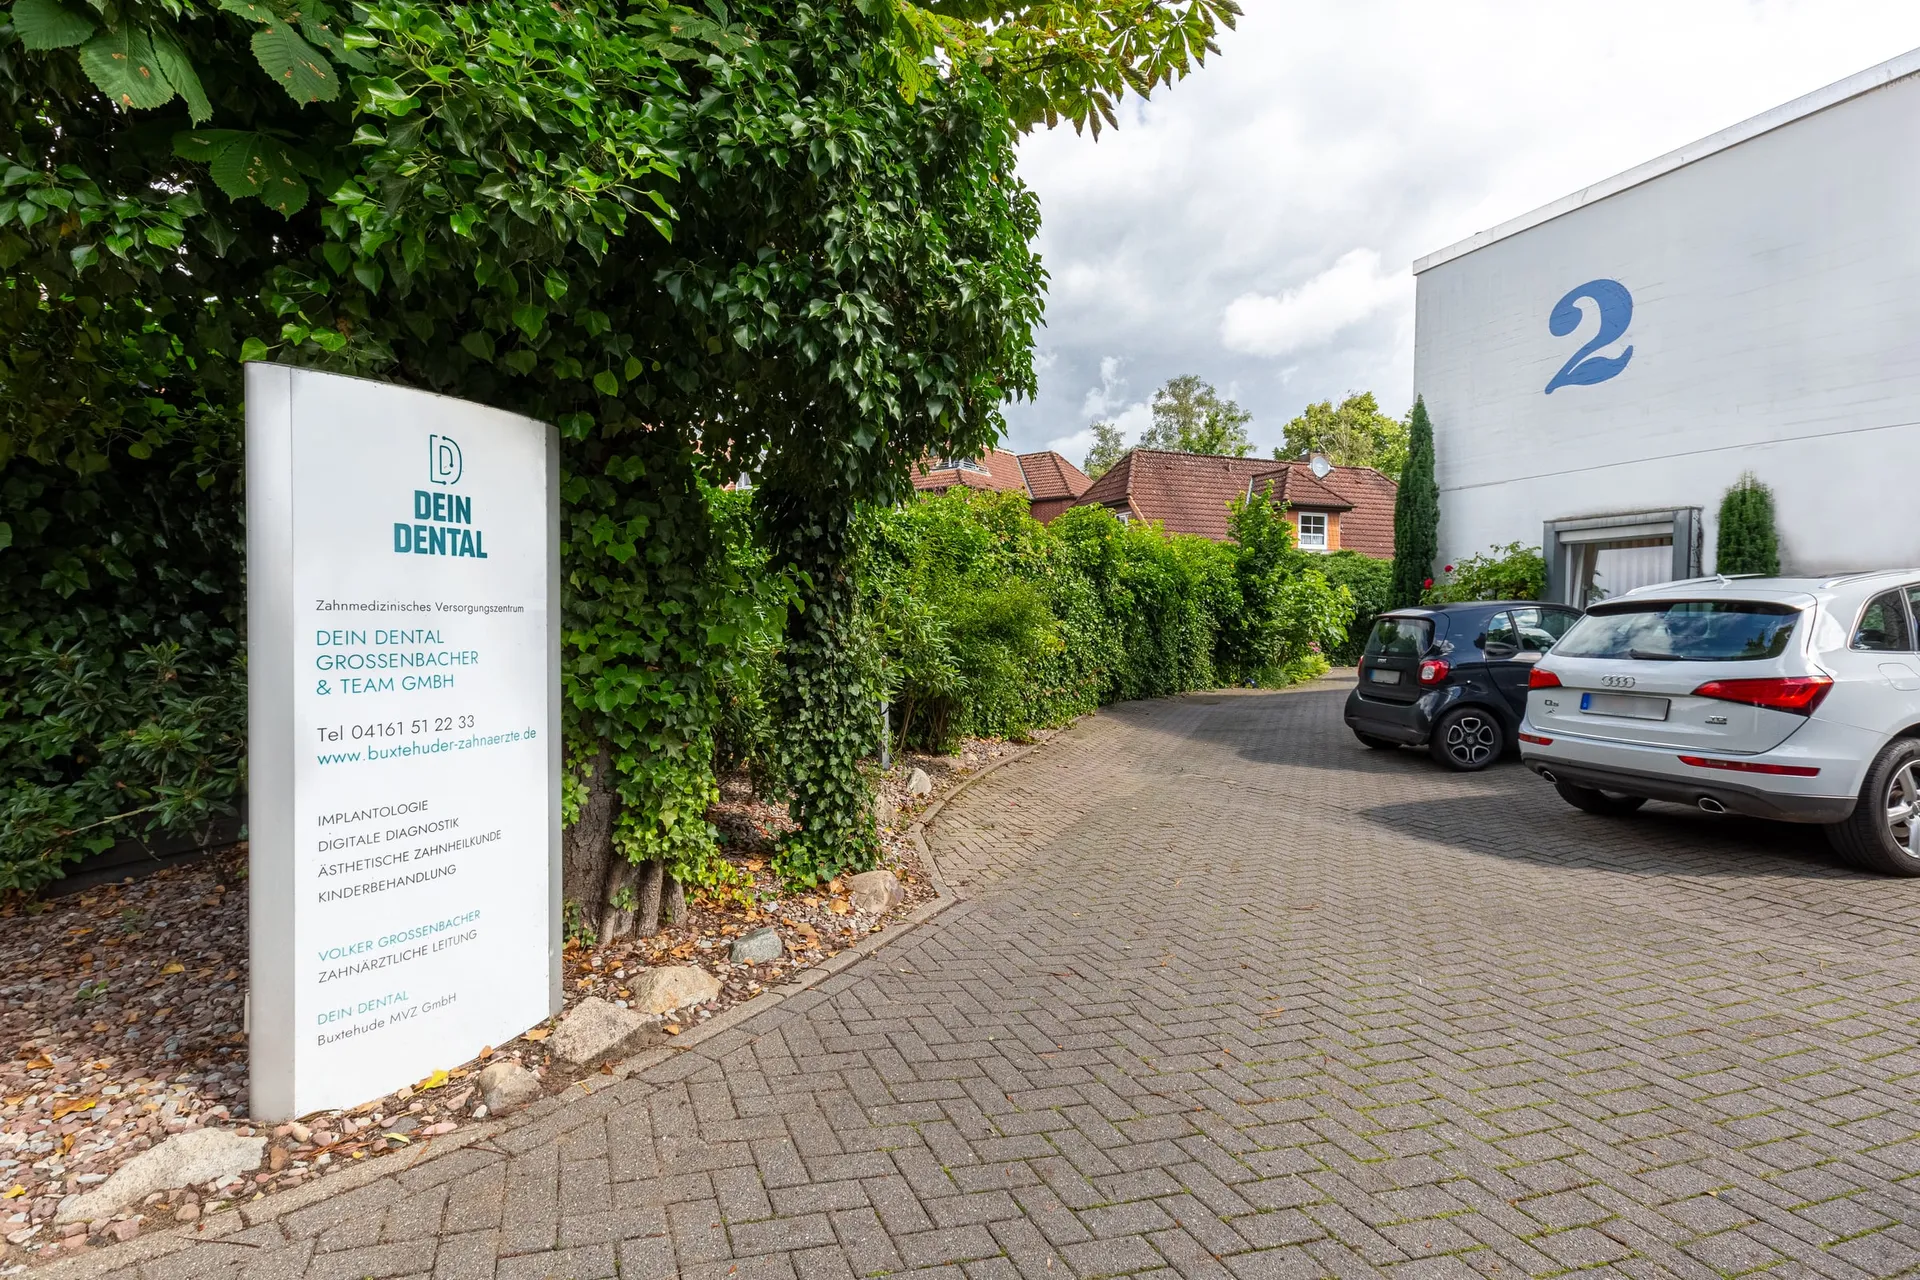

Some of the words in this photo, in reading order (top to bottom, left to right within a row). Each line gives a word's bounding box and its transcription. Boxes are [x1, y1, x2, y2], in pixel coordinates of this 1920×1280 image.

[1545, 278, 1633, 395] 2
[414, 490, 471, 525] DEIN
[394, 523, 488, 559] DENTAL
[316, 599, 432, 613] Zahnmedizinisches
[435, 602, 525, 616] Versorgungszentrum
[316, 630, 367, 646] DEIN
[375, 630, 445, 646] DENTAL
[316, 651, 479, 671] GROSSENBACHER
[316, 680, 332, 696] &
[340, 677, 395, 695] TEAM
[402, 674, 454, 692] GMBH
[317, 725, 344, 742] Tel
[351, 721, 403, 740] 04161
[411, 719, 428, 734] 51
[434, 717, 453, 732] 22
[458, 715, 475, 729] 33
[318, 800, 429, 827] IMPLANTOLOGIE
[318, 832, 381, 853] DIGITALE
[385, 818, 460, 842] DIAGNOSTIK
[318, 850, 410, 878] ÄSTHETISCHE
[413, 829, 502, 860] ZAHNHEILKUNDE
[318, 864, 457, 904] KINDERBEHANDLUNG
[318, 941, 374, 962] VOLKER
[377, 910, 481, 949] GROSSENBACHER
[318, 946, 429, 984] ZAHNÄRZTLICHE
[432, 930, 478, 953] LEITUNG
[317, 1006, 352, 1026] DEIN
[357, 991, 409, 1015] DENTAL
[317, 1018, 385, 1047] Buxtehude
[389, 1006, 418, 1025] MVZ
[421, 993, 457, 1014] GmbH
